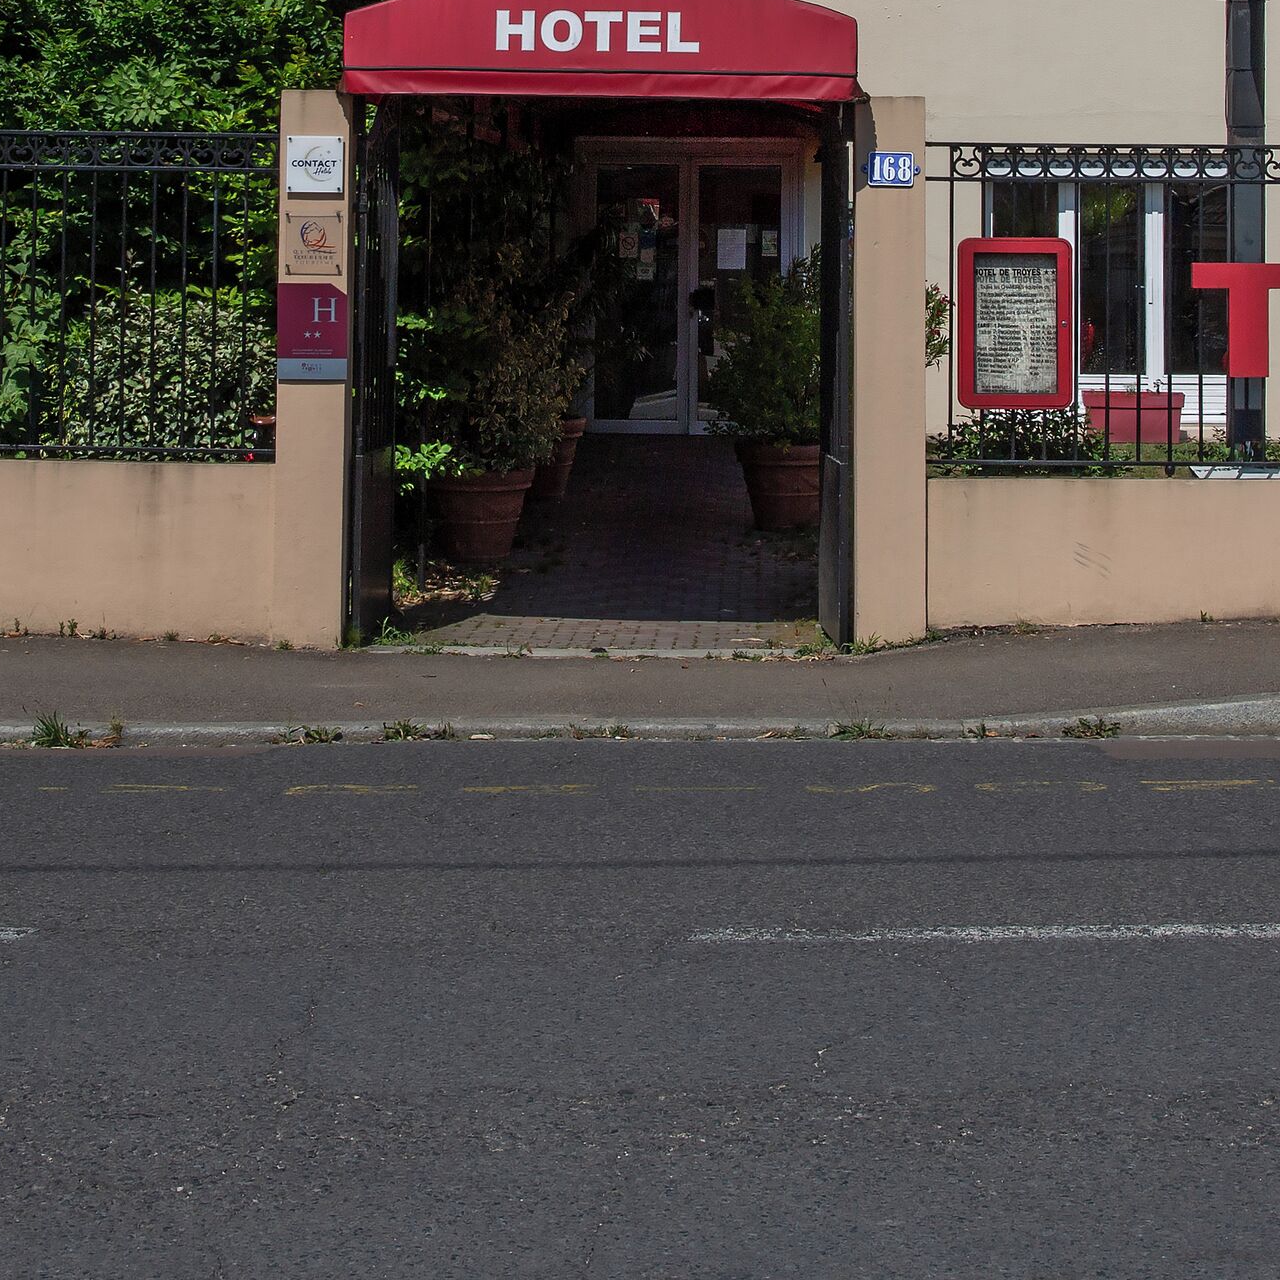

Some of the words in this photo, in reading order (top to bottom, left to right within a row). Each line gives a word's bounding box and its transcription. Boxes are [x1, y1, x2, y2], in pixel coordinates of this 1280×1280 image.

[496, 10, 700, 53] HOTEL
[291, 160, 337, 168] CONTACT
[873, 156, 911, 181] 168
[312, 297, 339, 323] H
